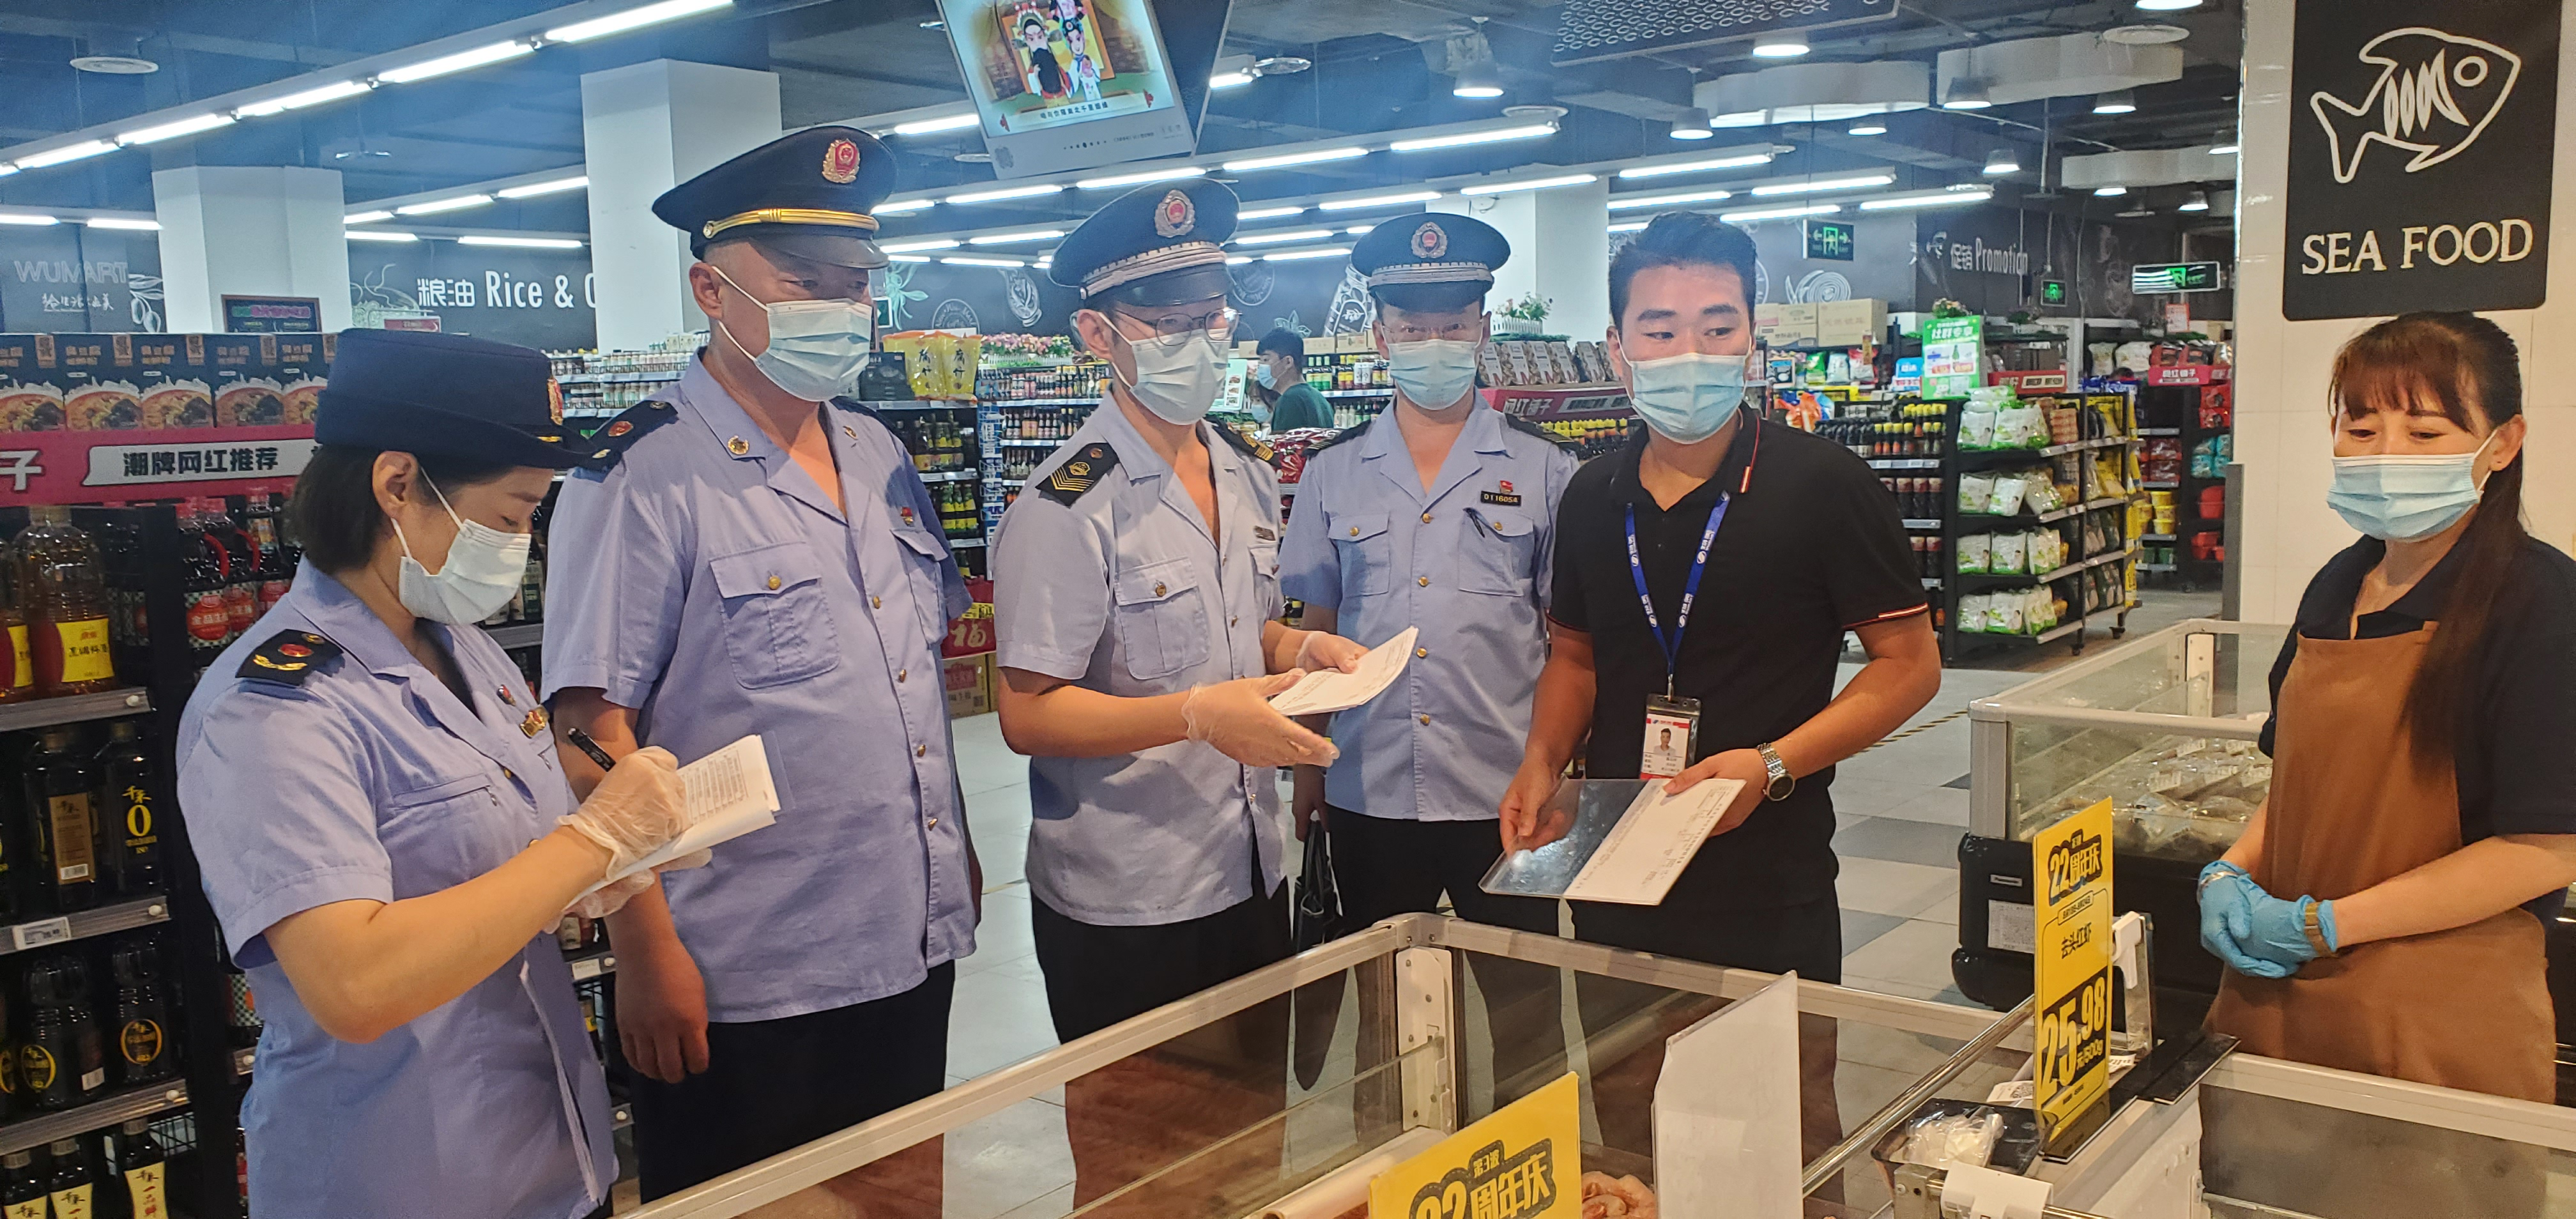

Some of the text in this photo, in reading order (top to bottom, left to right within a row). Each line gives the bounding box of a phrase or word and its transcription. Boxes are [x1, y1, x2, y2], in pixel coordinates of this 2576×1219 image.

[1975, 237, 2029, 275] Promotion
[2301, 218, 2534, 275] SEA FOOD
[13, 260, 128, 284] WUMART
[416, 278, 477, 308] 粮油
[485, 270, 543, 309] Rice
[554, 275, 574, 309] &
[123, 447, 279, 477] 潮牌网红推荐
[2050, 842, 2101, 899] 22周年庆
[2037, 976, 2106, 1110] 25.98
